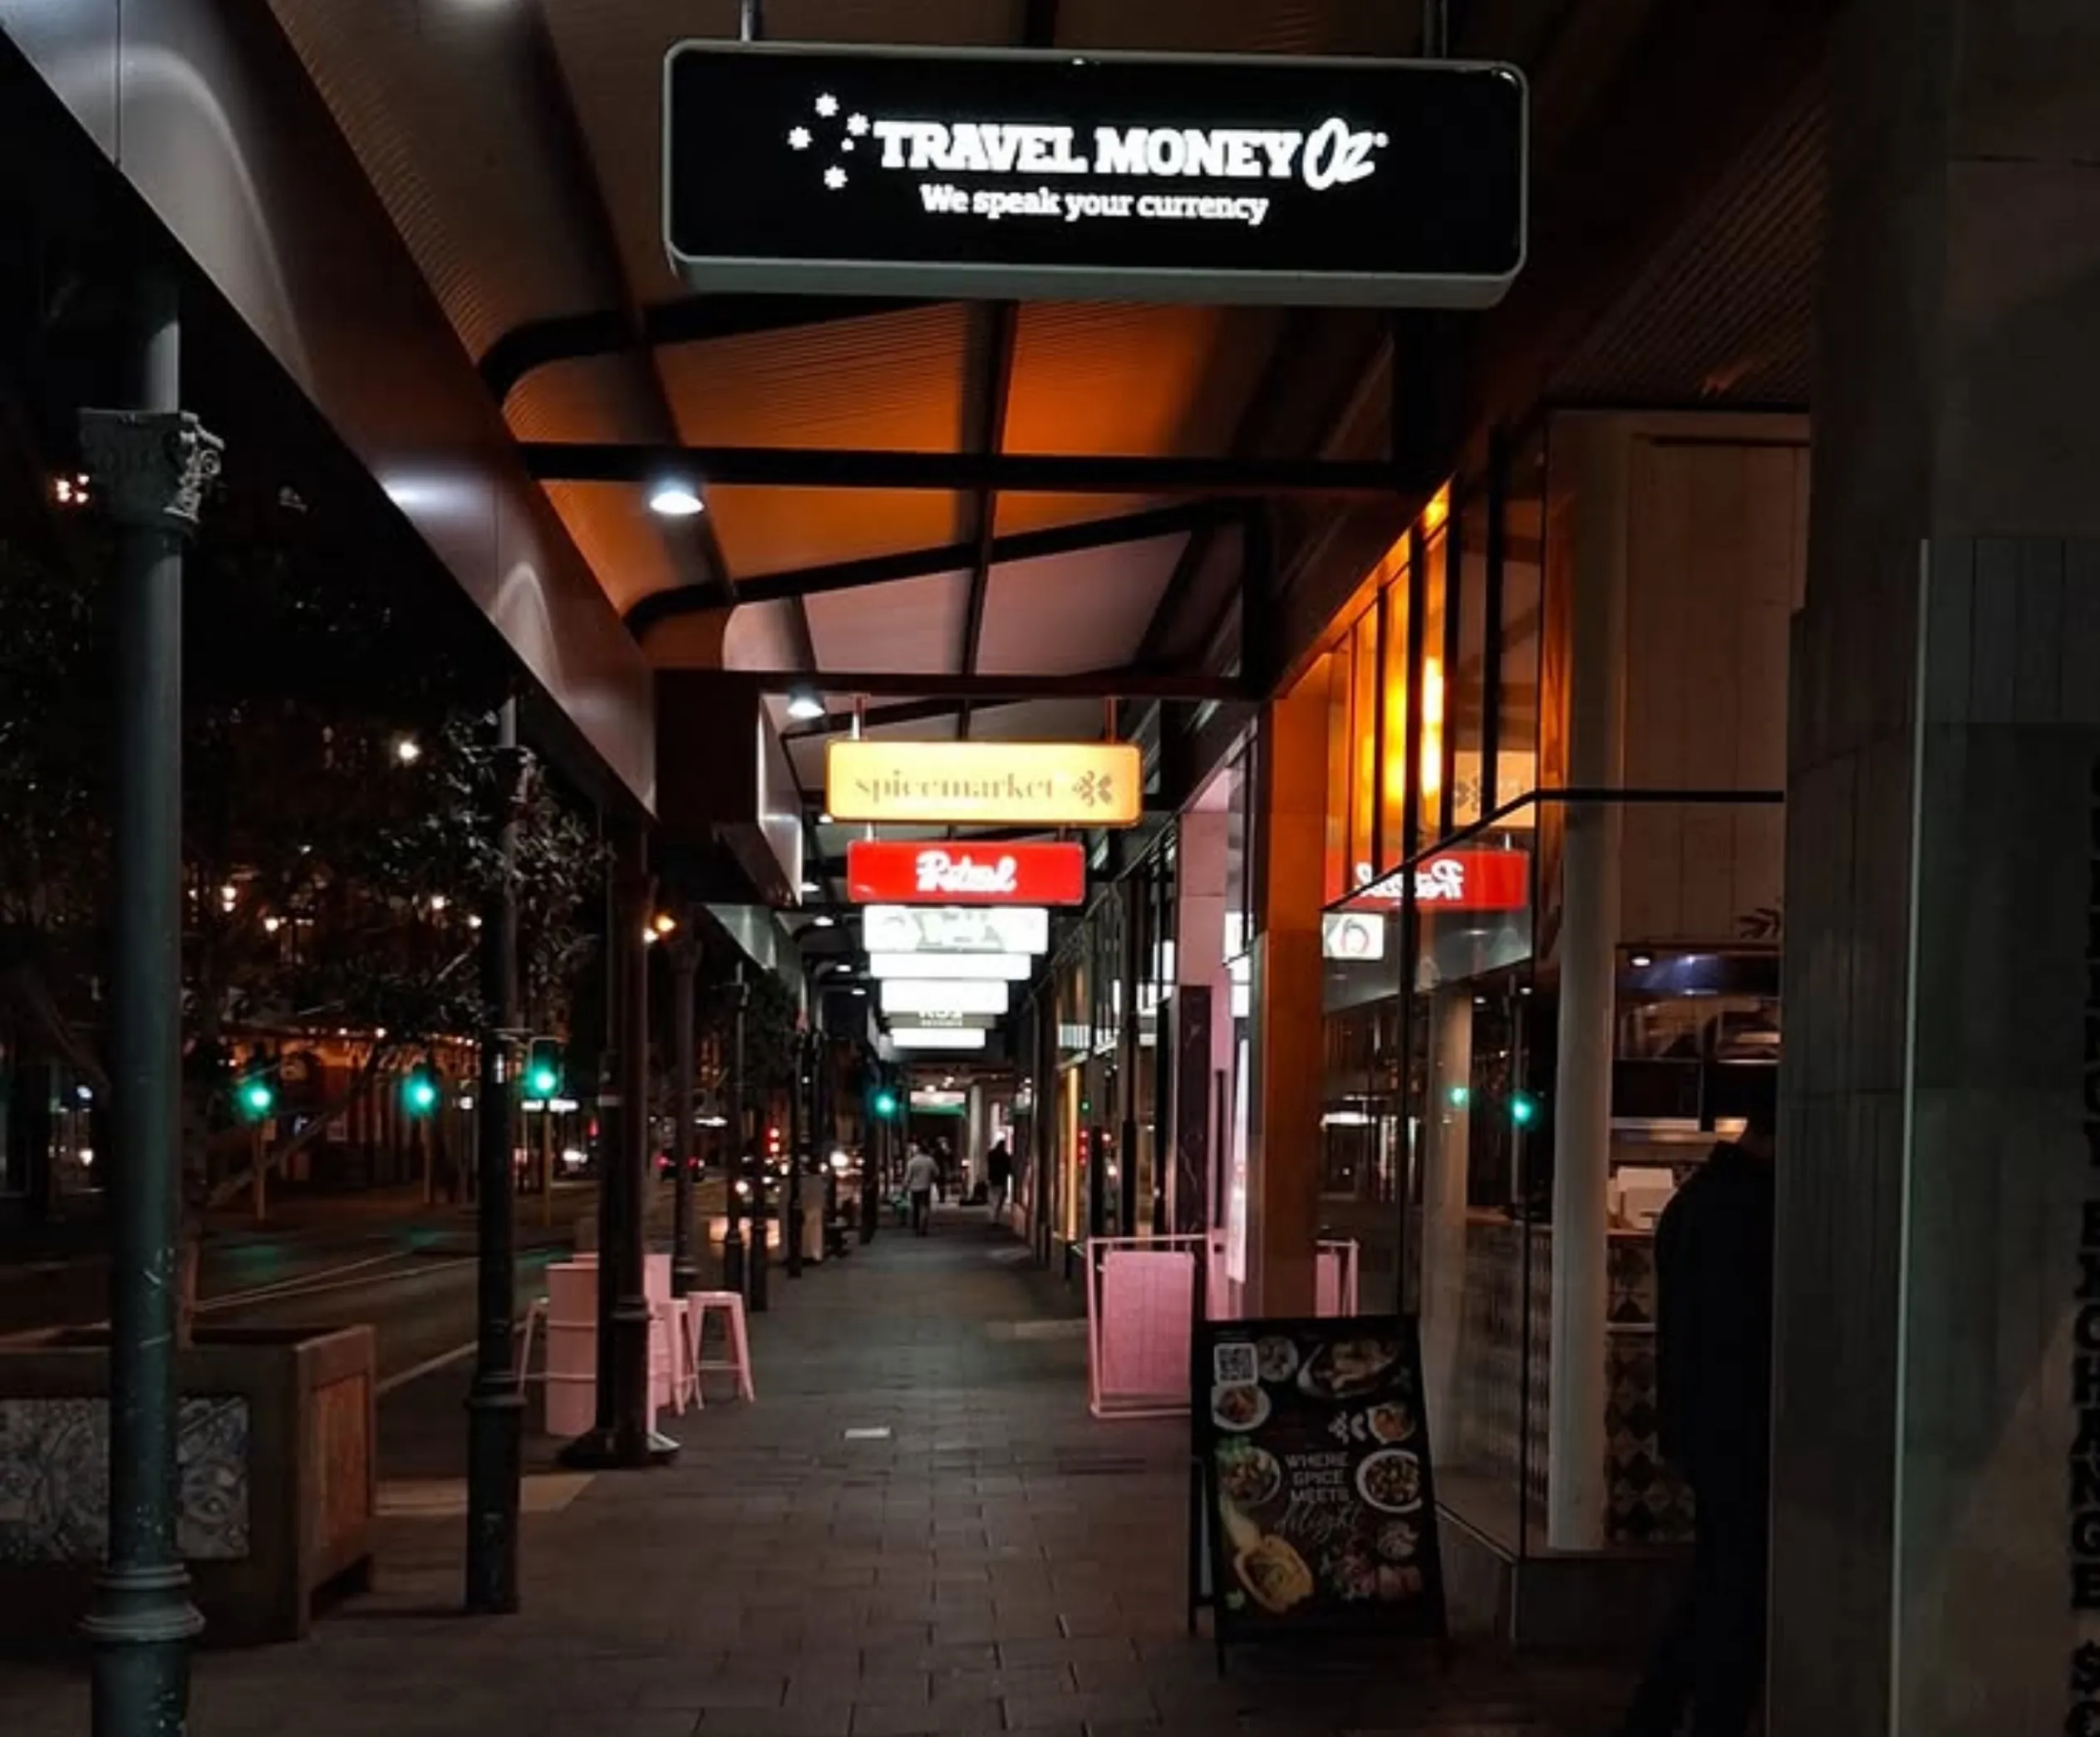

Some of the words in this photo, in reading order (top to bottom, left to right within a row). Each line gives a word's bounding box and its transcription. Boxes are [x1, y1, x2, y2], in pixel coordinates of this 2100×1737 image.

[873, 121, 1089, 174] TRAVEL
[1094, 126, 1303, 179] MONEY
[918, 184, 969, 212] We
[972, 185, 1062, 219] speak
[1064, 194, 1134, 221] your
[1136, 195, 1270, 227] currency
[854, 769, 1053, 804] spicemarket
